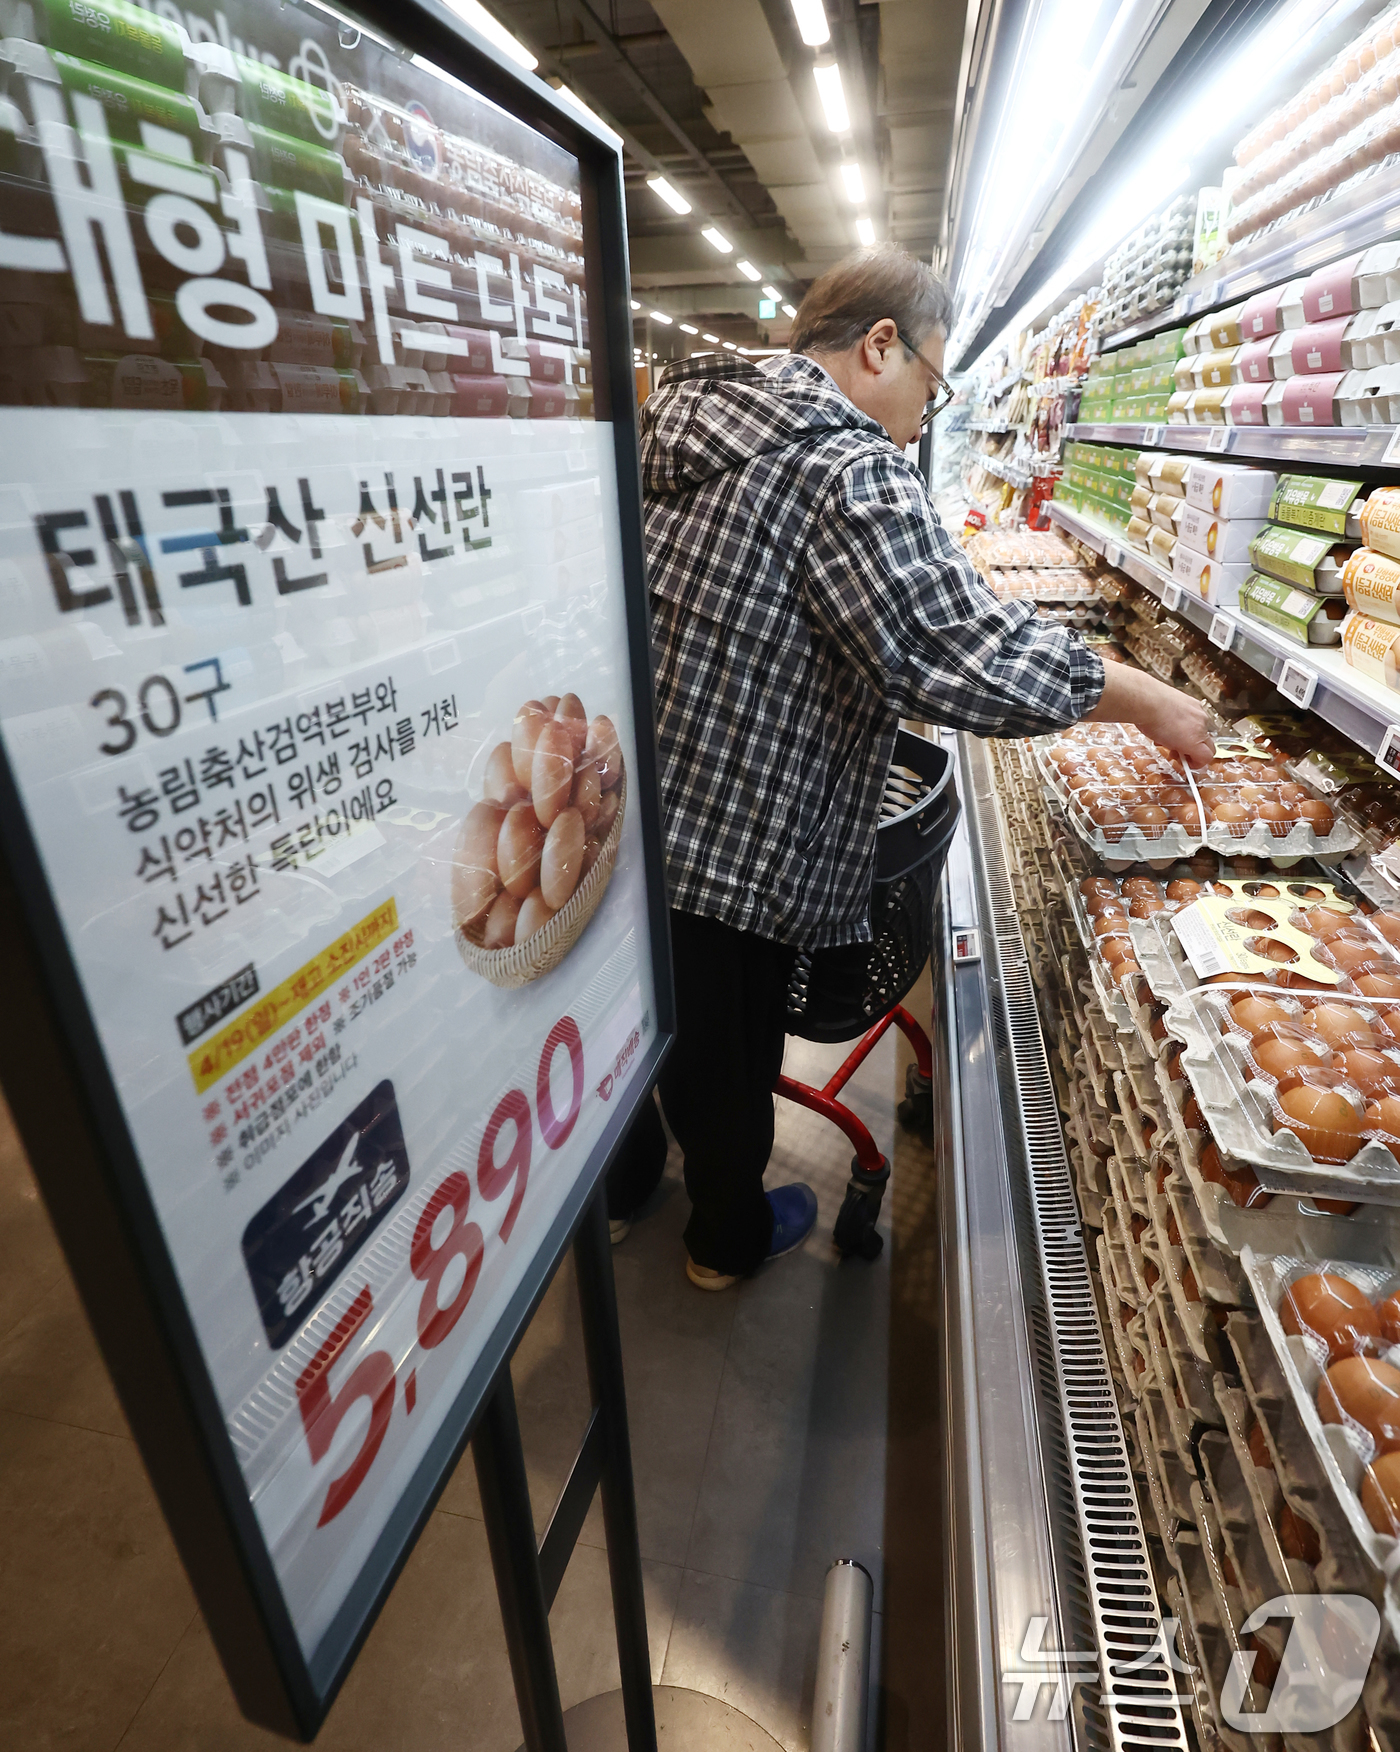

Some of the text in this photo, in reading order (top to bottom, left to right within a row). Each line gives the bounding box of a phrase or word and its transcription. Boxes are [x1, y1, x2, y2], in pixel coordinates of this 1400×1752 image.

[294, 190, 469, 366] 마트
[474, 250, 587, 385] 단독!
[33, 465, 492, 627] 태국산 신선란
[1355, 576, 1394, 603] 1등급 신선란
[90, 657, 232, 757] 30구
[1353, 631, 1388, 662] 1등급 신선란
[117, 676, 397, 834] 농림축산검역본부와
[136, 694, 459, 883] 식약처의 위생 검사를 거친
[152, 778, 398, 952] 신선한 특란이에요
[182, 969, 258, 1037] 행사기간
[304, 1000, 332, 1036] 한정
[352, 966, 371, 991] 1인
[373, 949, 391, 975] 2판
[392, 929, 414, 958] 한정
[396, 952, 417, 976] 가능
[242, 1121, 291, 1171] 이미지
[294, 1055, 358, 1123] 사진입니다
[277, 1159, 401, 1316] 항공직송
[295, 1015, 585, 1530] 5,890
